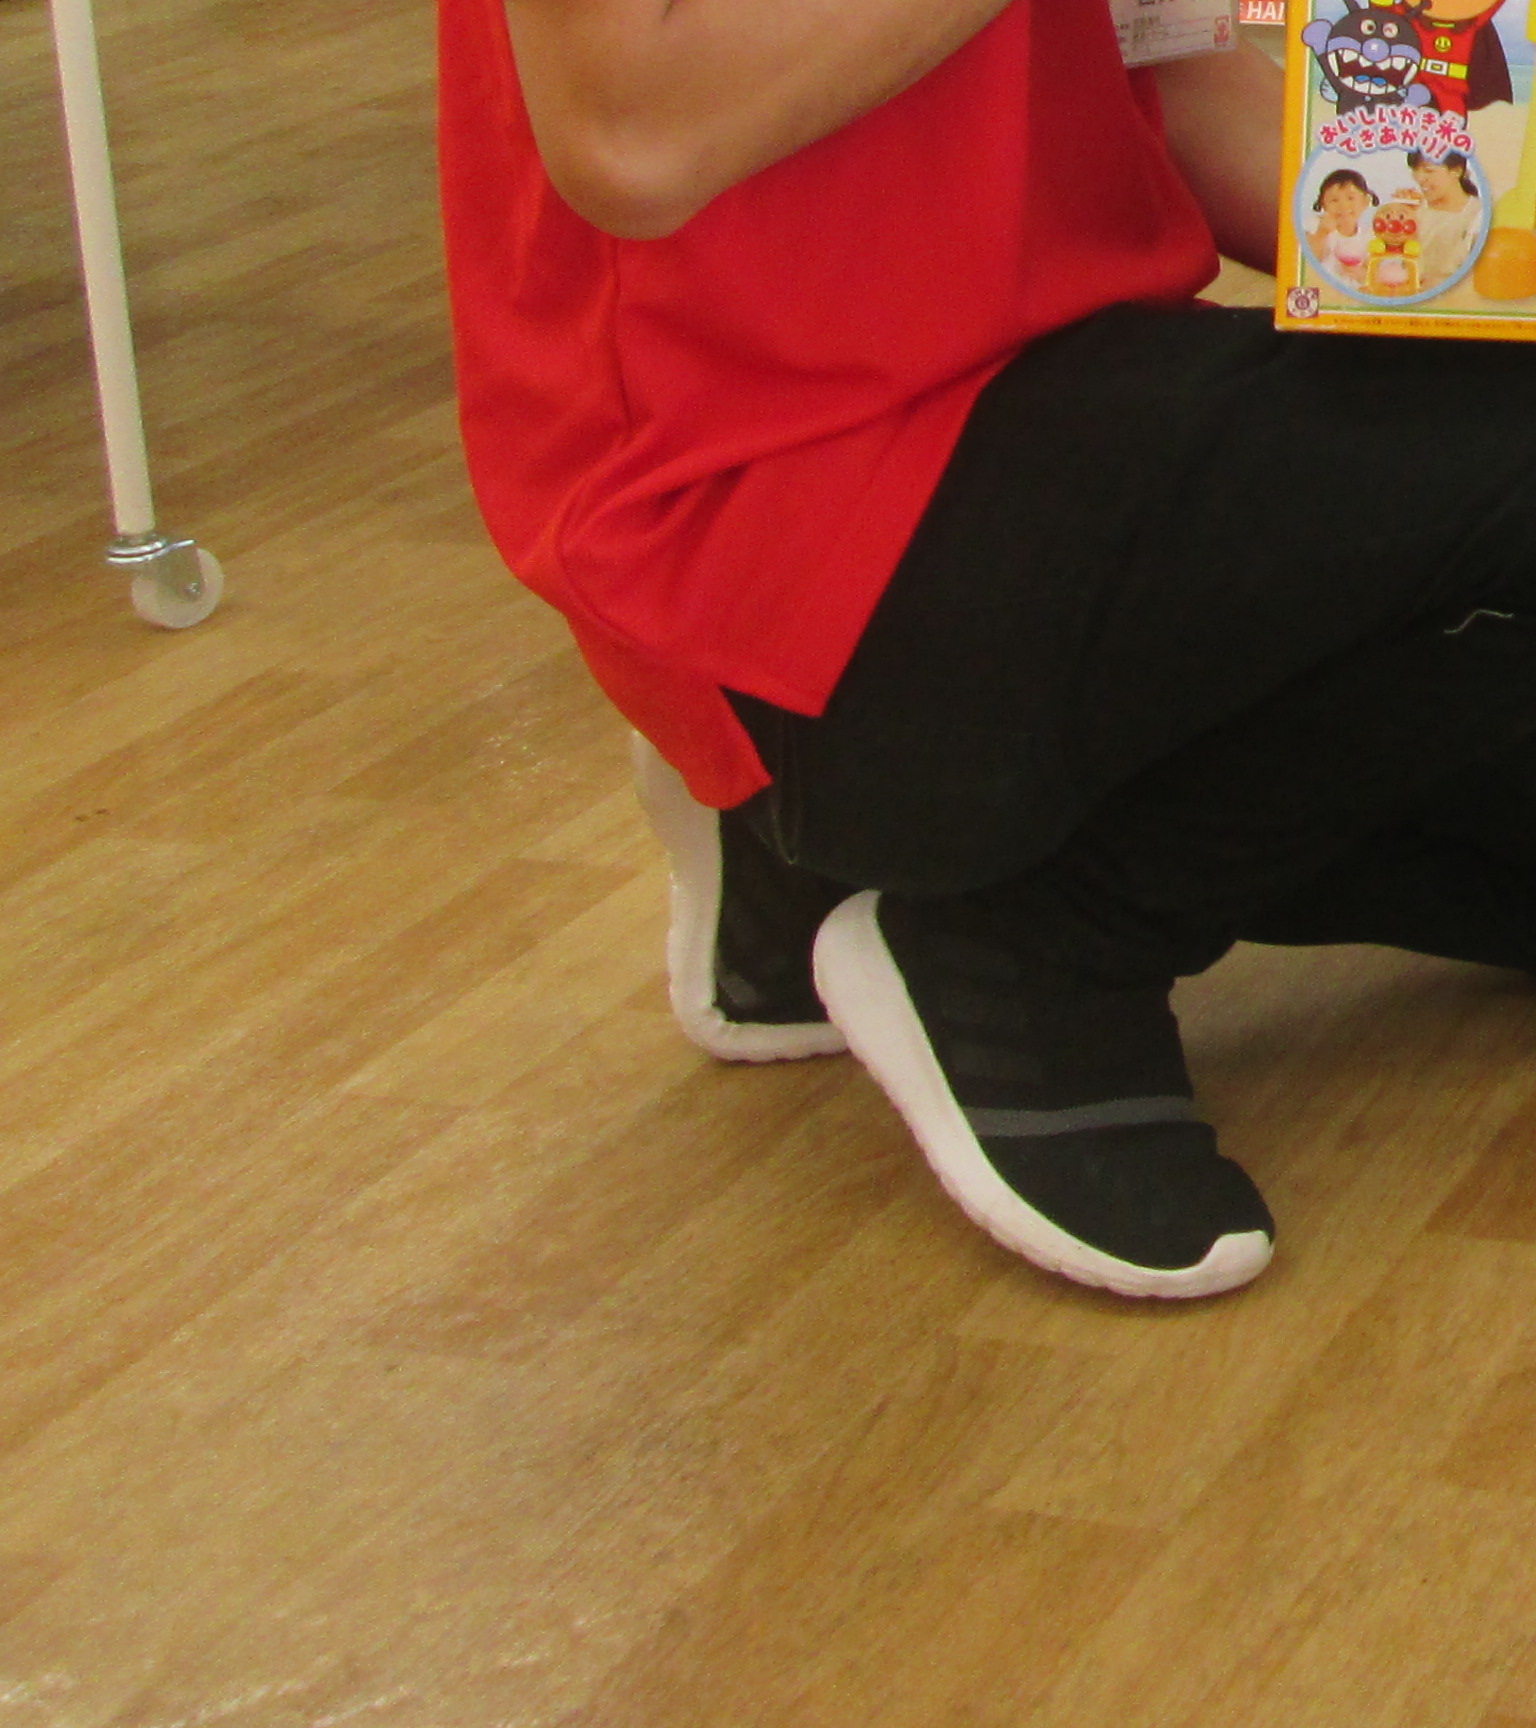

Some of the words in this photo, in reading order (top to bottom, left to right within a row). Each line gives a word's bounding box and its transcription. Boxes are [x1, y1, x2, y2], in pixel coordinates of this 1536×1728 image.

[1319, 108, 1473, 153] おいしいかき氷の
[1339, 126, 1448, 160] できあがり!
